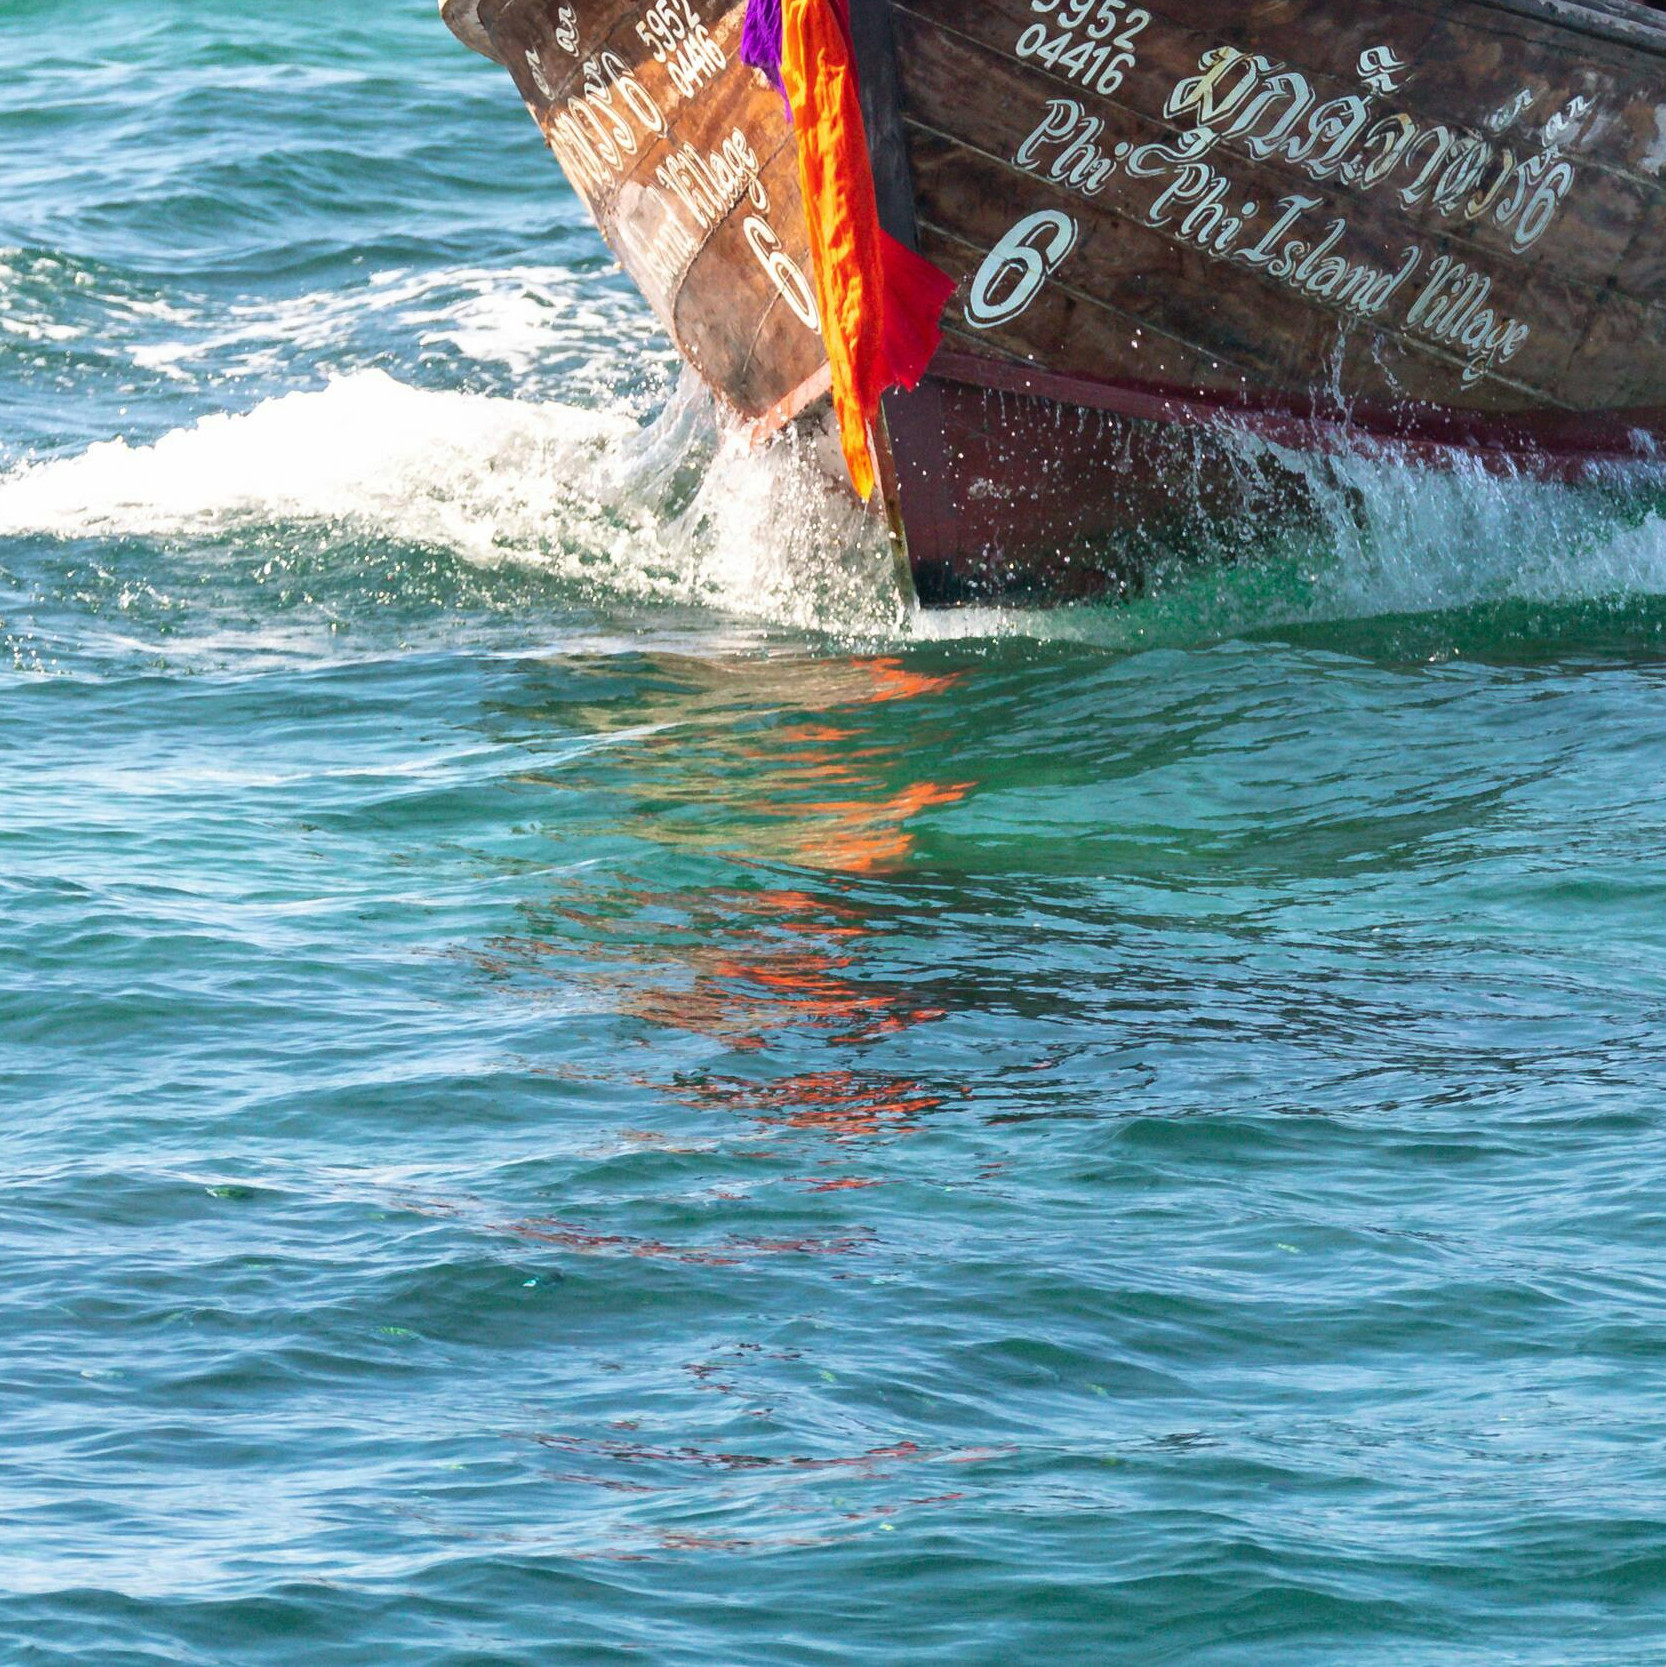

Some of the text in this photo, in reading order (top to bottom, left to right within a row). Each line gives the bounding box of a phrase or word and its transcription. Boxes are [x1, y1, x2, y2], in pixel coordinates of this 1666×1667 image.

[665, 24, 727, 99] 04416
[1015, 22, 1136, 95] 04416
[658, 128, 771, 235] Village
[742, 213, 823, 337] 6
[963, 208, 1079, 330] 6
[1011, 99, 1531, 390] Phi Phi Island Village
